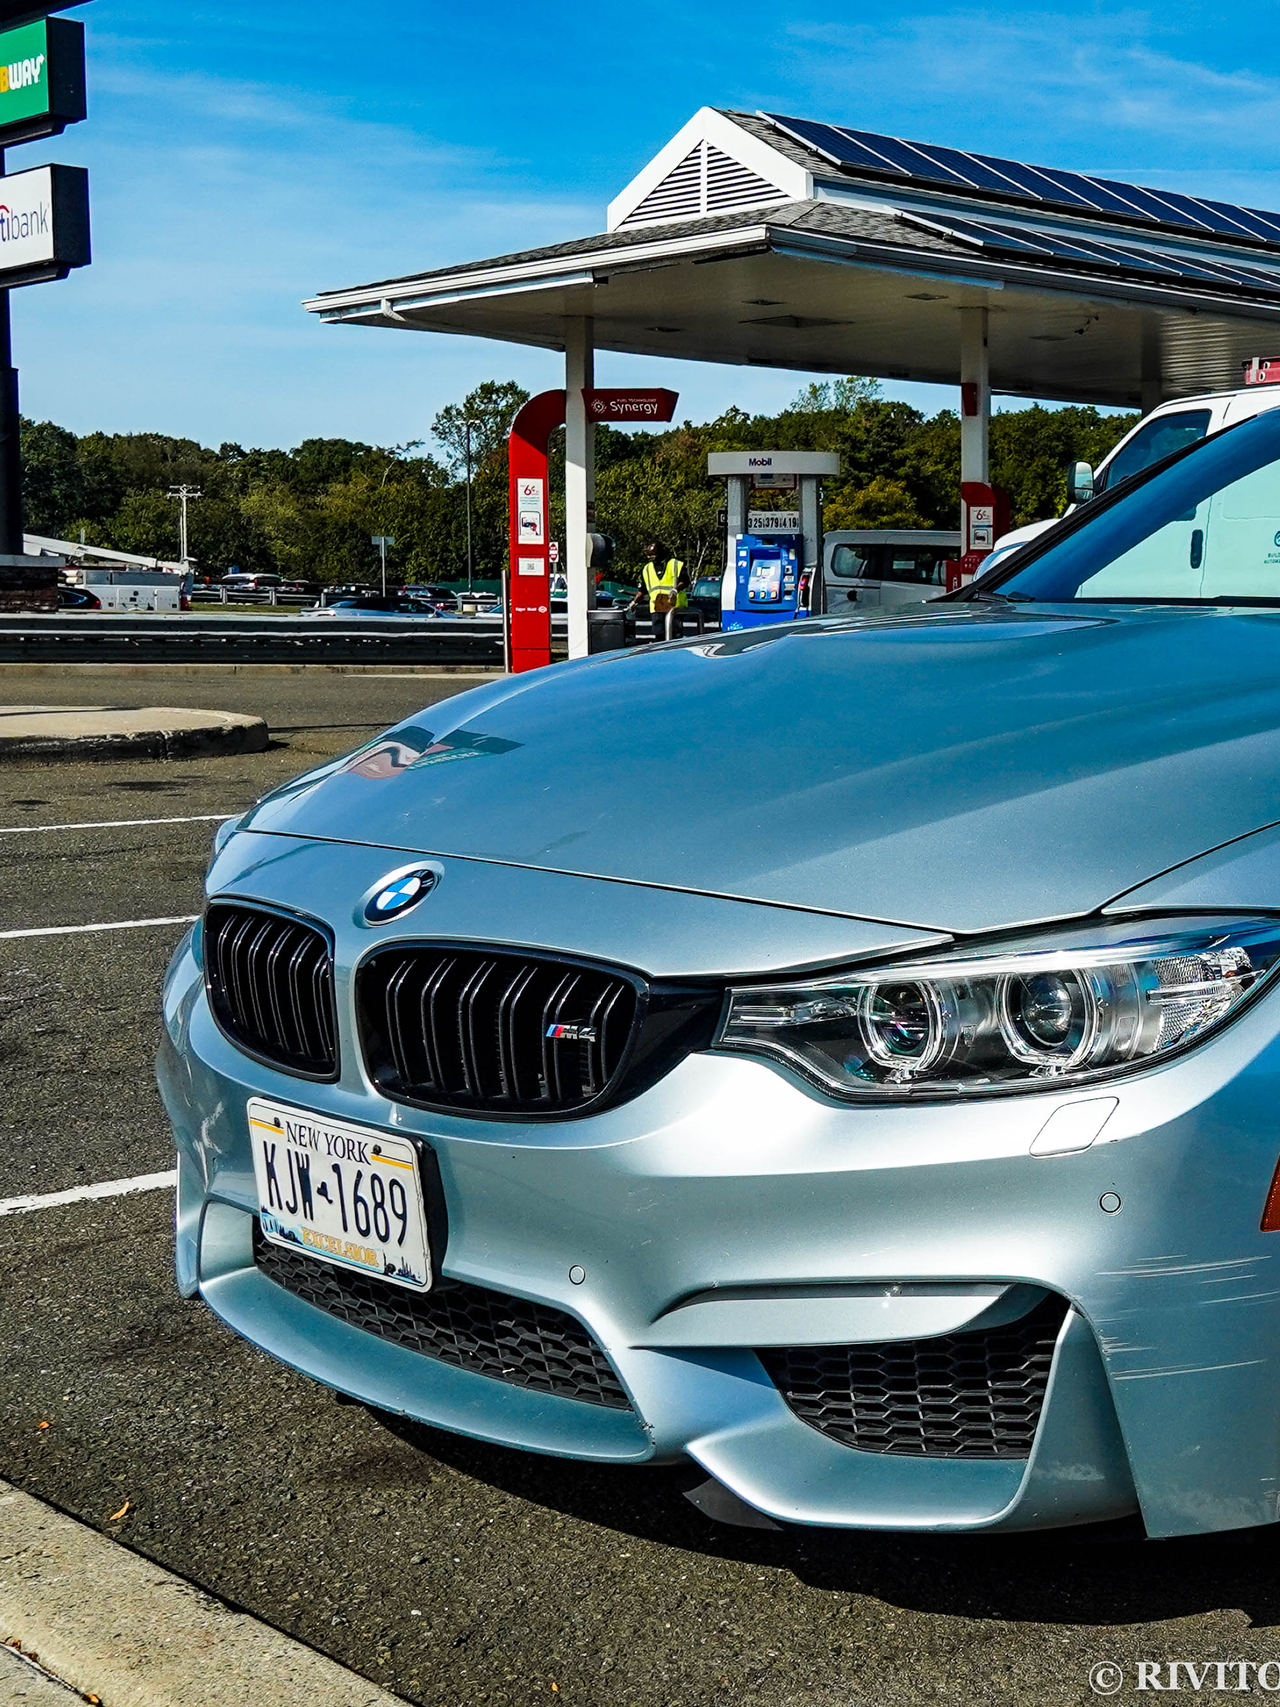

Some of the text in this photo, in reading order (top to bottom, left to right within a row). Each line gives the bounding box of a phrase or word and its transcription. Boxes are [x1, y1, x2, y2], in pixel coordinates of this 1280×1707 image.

[610, 401, 658, 415] Synergy
[749, 458, 772, 466] Mobil
[559, 1024, 596, 1042] M4
[286, 1121, 371, 1165] NEW YORK
[302, 1227, 379, 1267] EXCELSIOR
